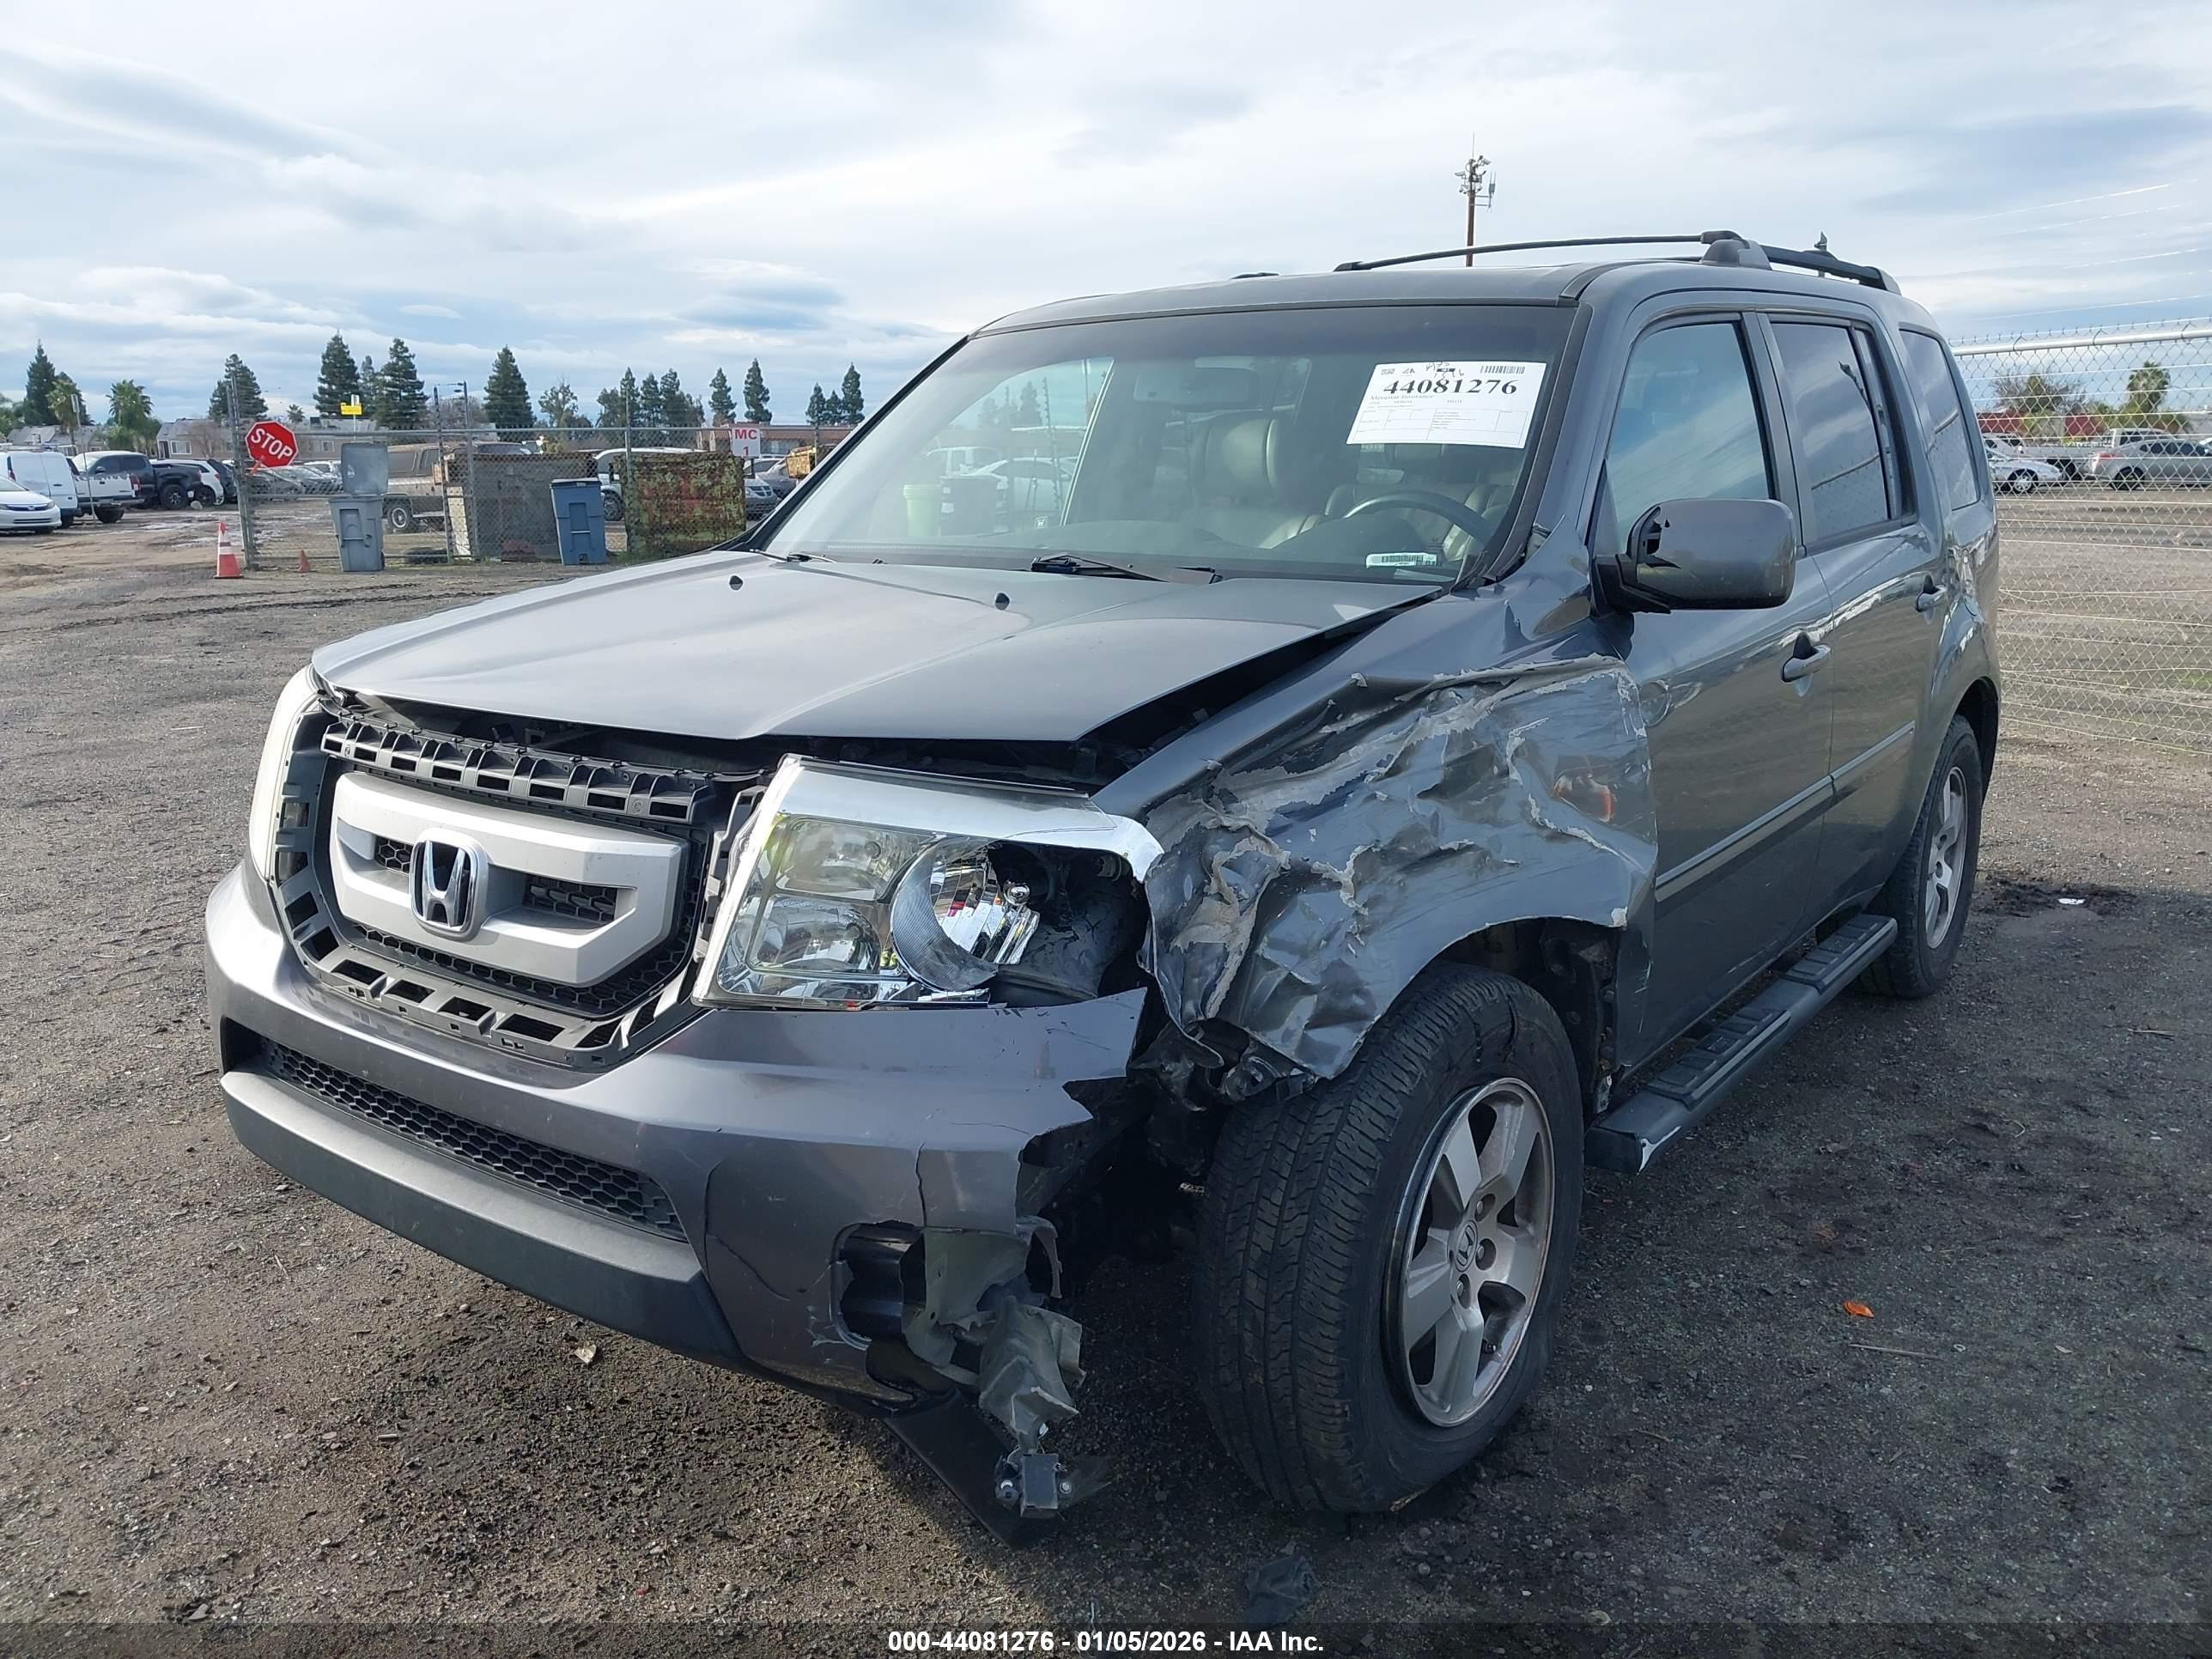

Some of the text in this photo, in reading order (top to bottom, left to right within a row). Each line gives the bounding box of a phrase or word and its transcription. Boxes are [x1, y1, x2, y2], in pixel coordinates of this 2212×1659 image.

[1382, 379, 1519, 395] 44081276
[734, 429, 758, 440] MC
[251, 428, 294, 460] STOP
[743, 446, 750, 456] 1
